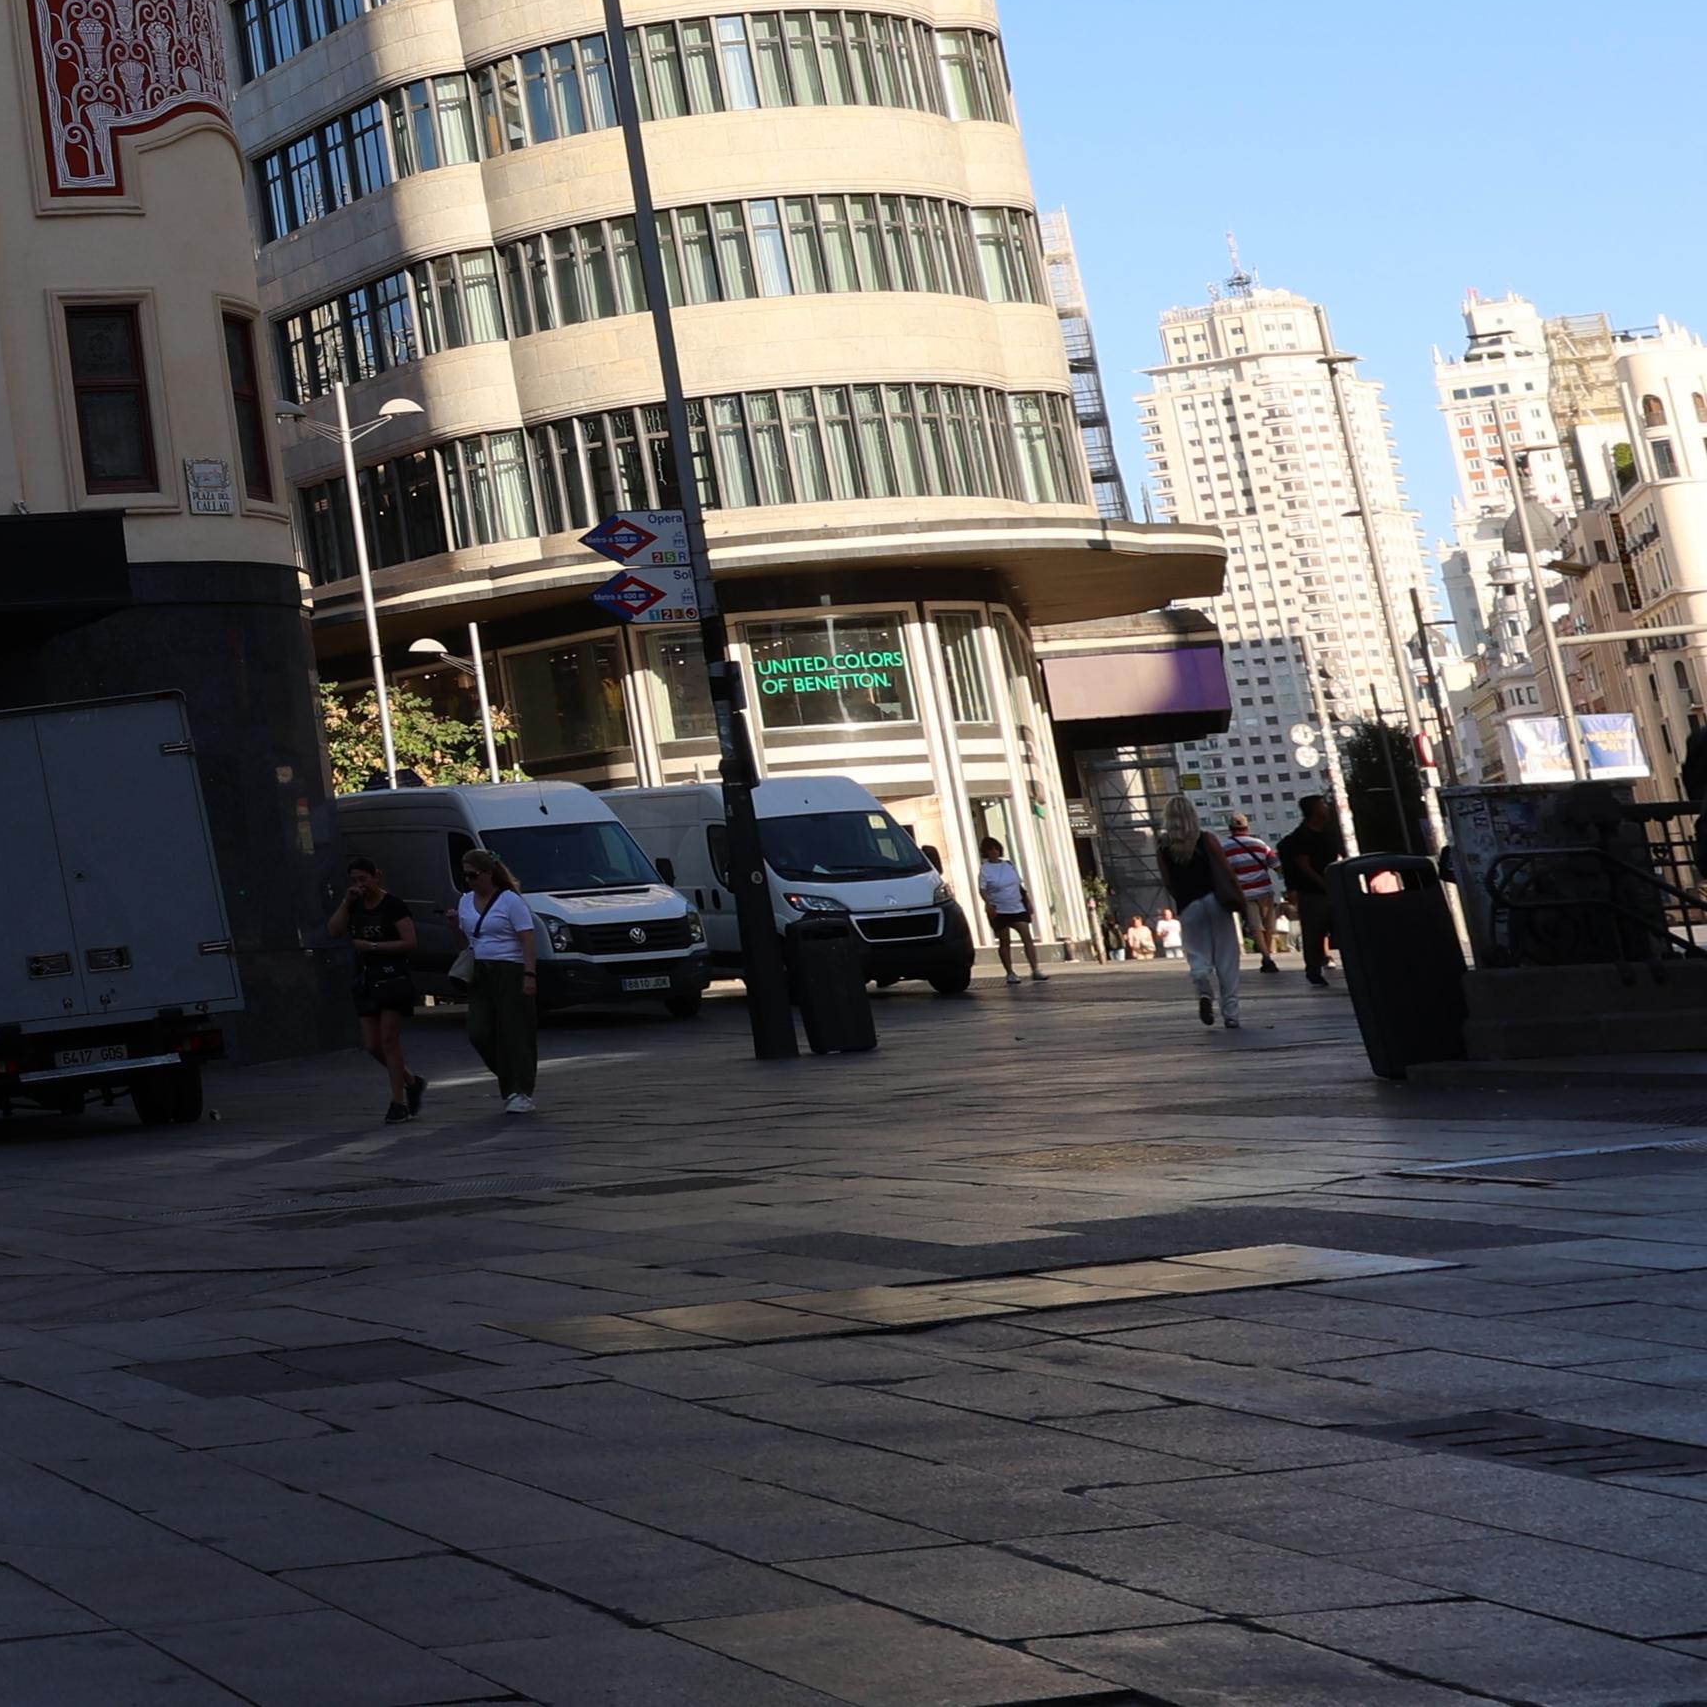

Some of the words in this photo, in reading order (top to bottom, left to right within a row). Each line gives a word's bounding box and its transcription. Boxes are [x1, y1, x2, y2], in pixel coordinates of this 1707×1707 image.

[192, 491, 216, 501] PLAZA
[196, 500, 230, 512] CALLAO
[585, 536, 608, 544] Metro
[653, 553, 662, 563] 2
[678, 552, 686, 561] R
[673, 570, 692, 580] Sol
[593, 593, 616, 601] Metro
[757, 656, 828, 675] UNITED
[832, 651, 903, 669] COLORS
[762, 678, 788, 694] OF
[793, 672, 892, 693] BENETTON.
[62, 1050, 92, 1064] 6417
